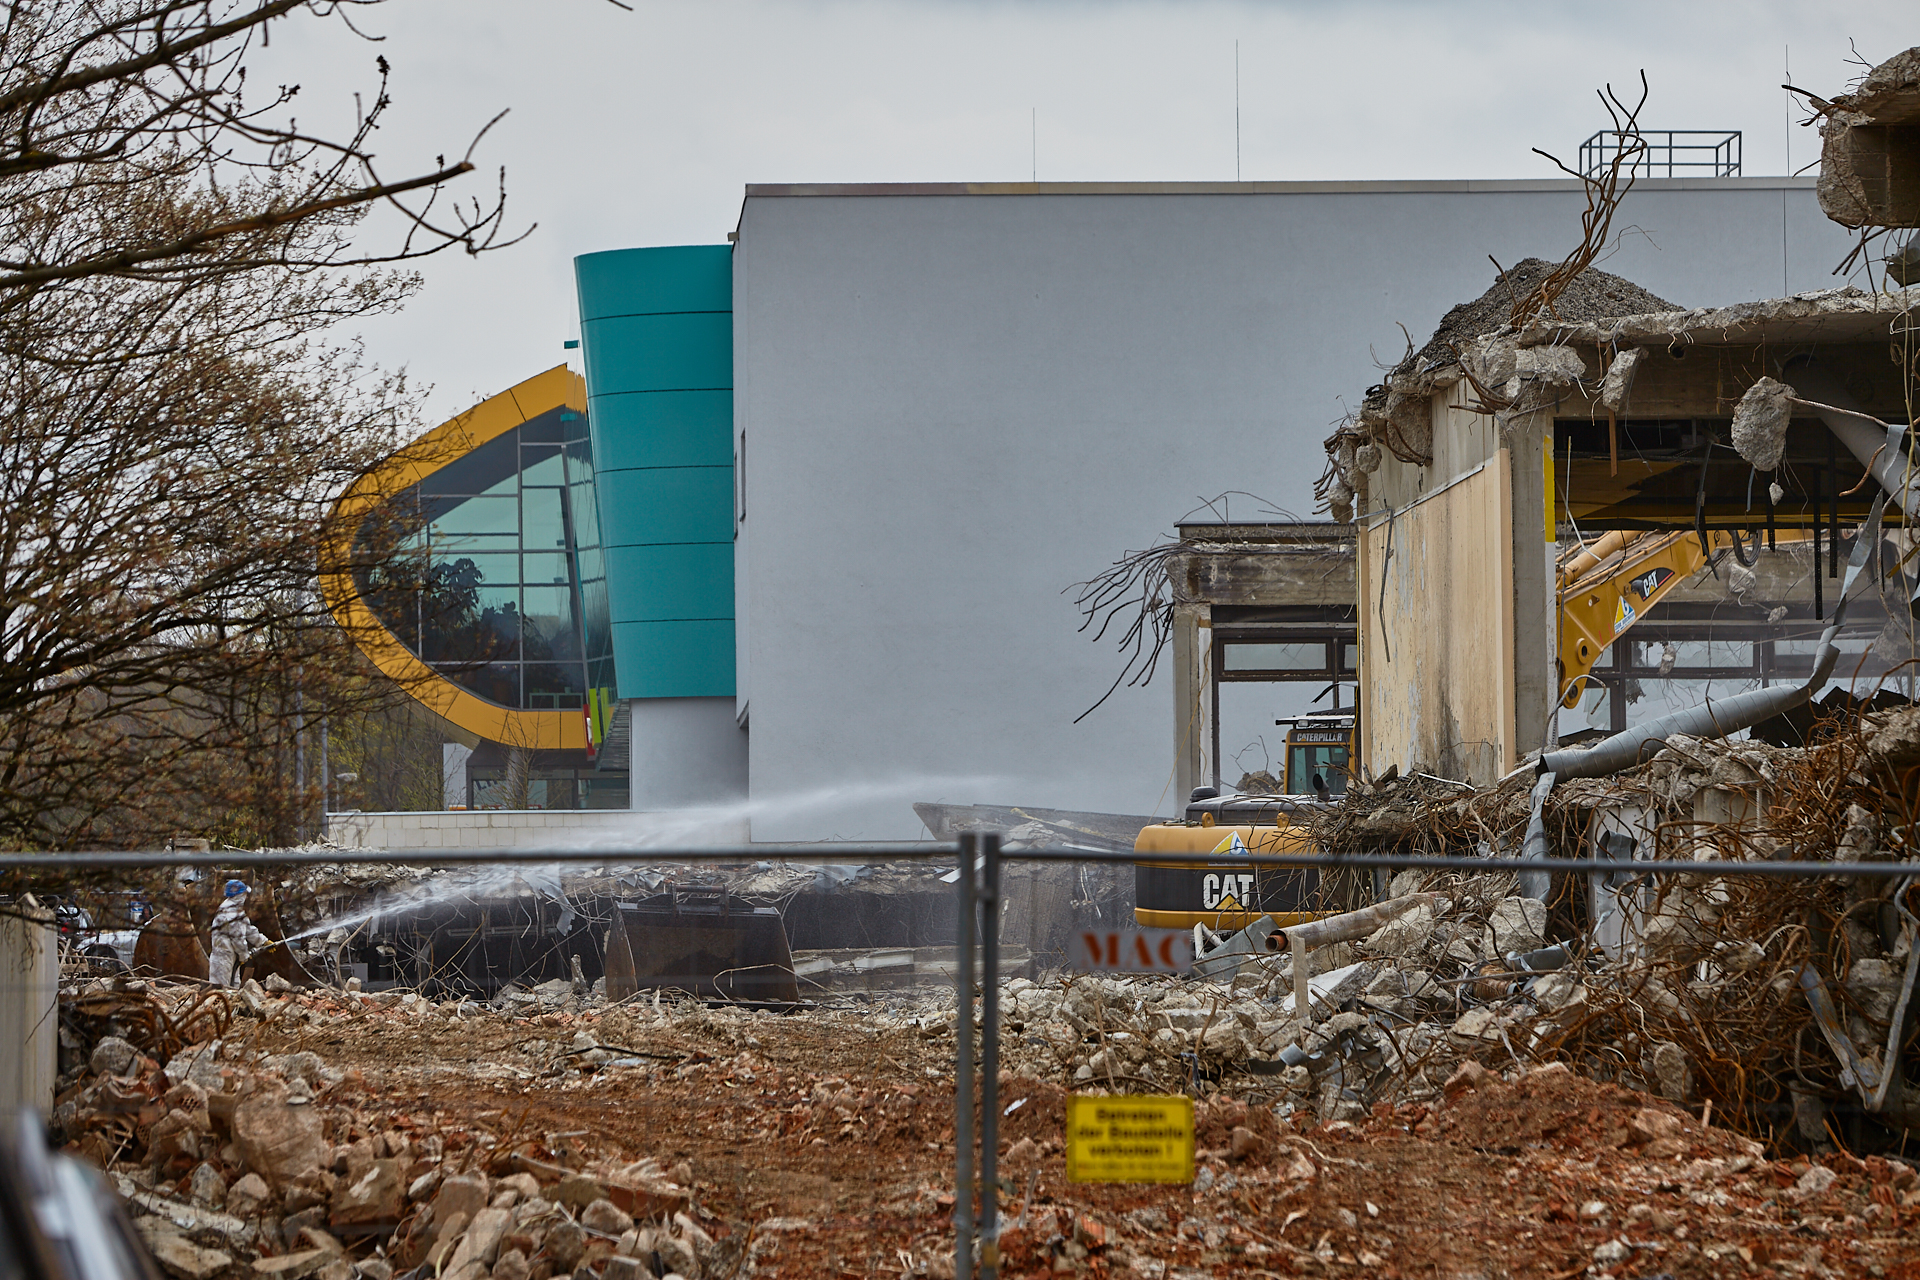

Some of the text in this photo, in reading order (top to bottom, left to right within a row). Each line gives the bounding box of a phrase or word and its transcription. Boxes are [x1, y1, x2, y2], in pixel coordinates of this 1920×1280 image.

[1643, 569, 1659, 598] CAT
[1296, 732, 1343, 742] CATERPILLAR
[1203, 873, 1254, 910] CAT
